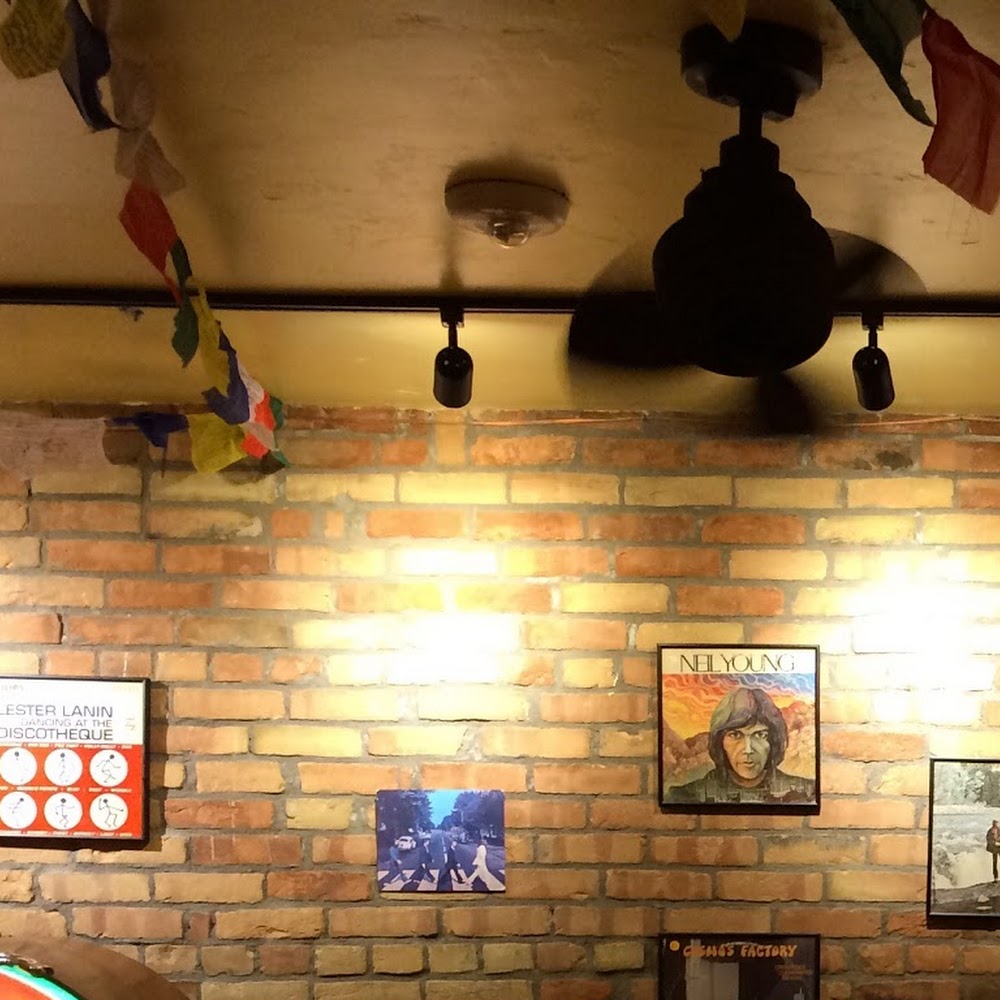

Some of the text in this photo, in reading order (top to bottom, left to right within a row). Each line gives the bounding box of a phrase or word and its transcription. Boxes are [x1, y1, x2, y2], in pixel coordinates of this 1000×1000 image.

[680, 654, 795, 672] NEIL YOUNG
[62, 705, 113, 718] LANIN
[21, 718, 113, 729] DANCING AT THE
[0, 727, 114, 741] DISCOTHEQUE
[741, 944, 798, 959] FACTORY
